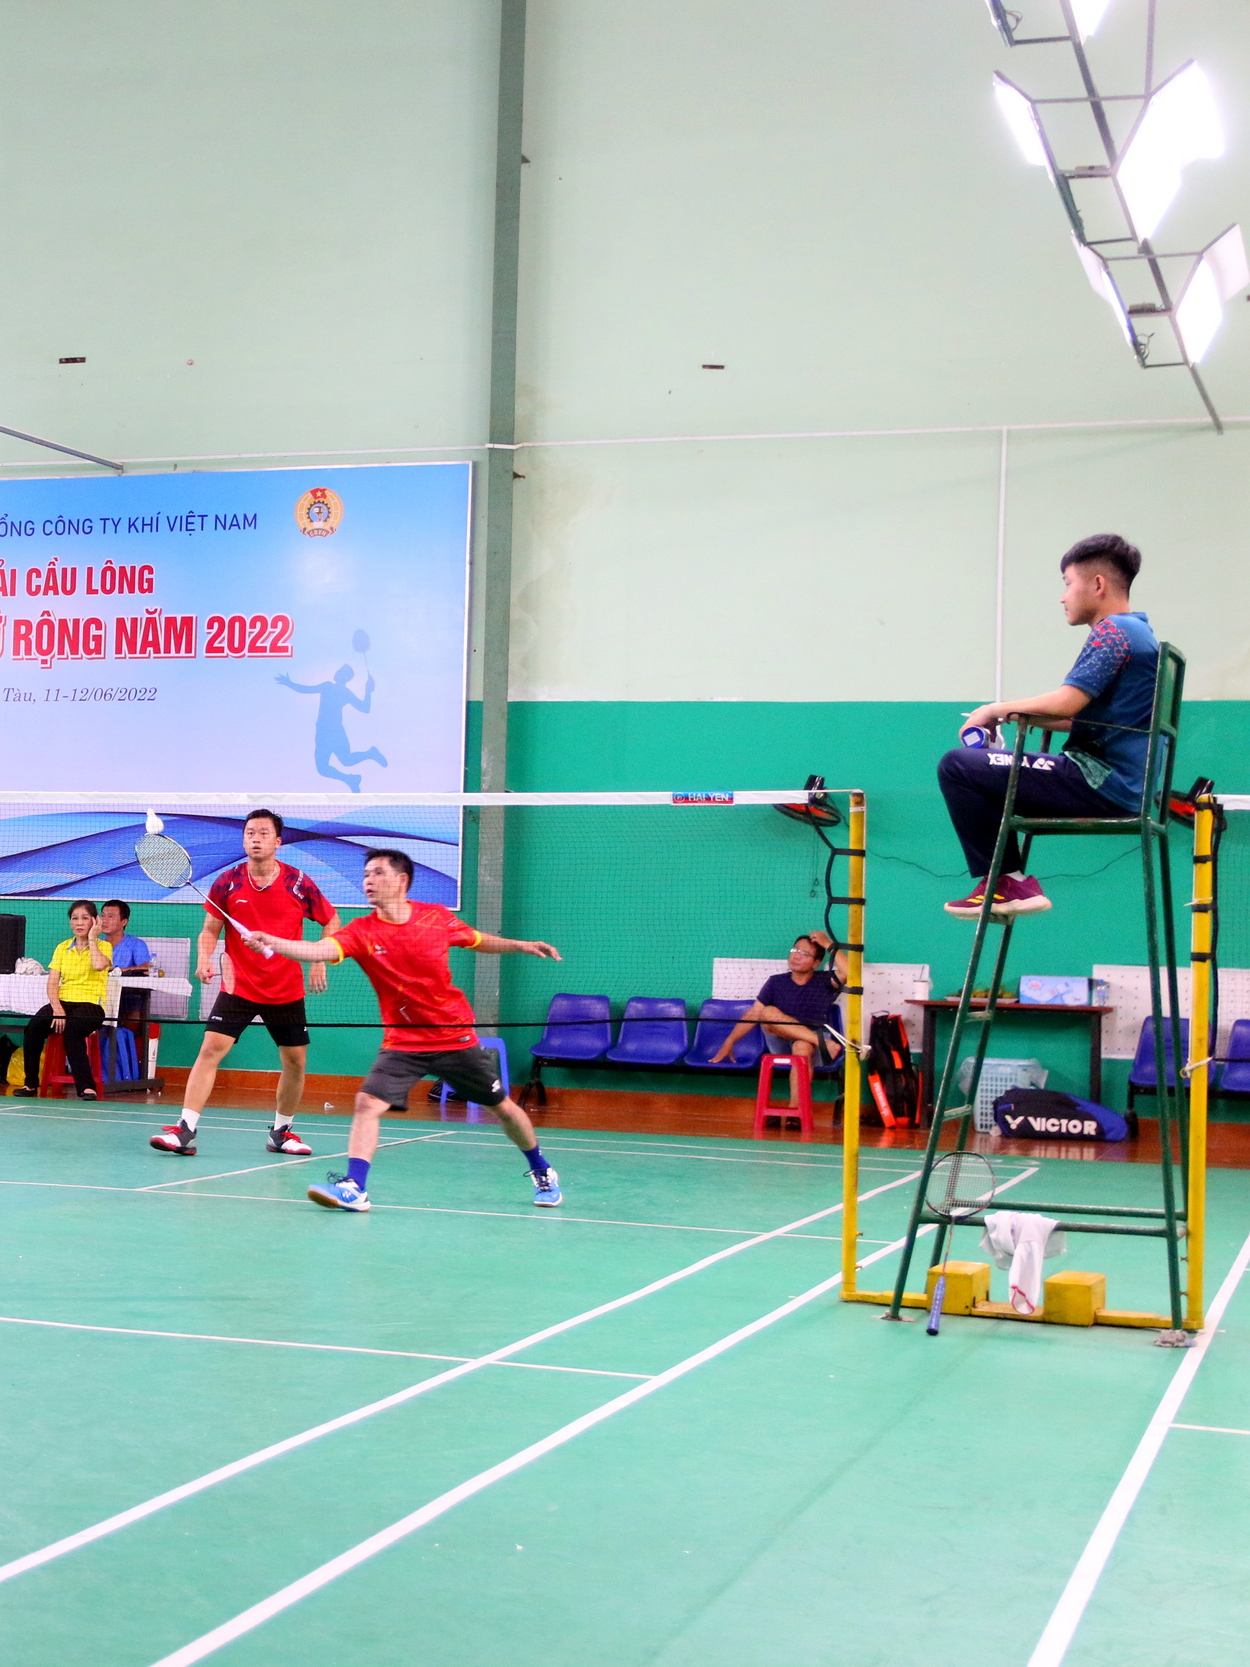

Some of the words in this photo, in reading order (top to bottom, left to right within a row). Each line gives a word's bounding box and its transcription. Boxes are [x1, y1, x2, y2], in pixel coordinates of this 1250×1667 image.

[42, 514, 94, 537] CÔNG
[99, 517, 122, 535] TY
[127, 511, 162, 534] KHÍ
[166, 510, 209, 537] VIỆT
[213, 512, 258, 532] NAM
[25, 556, 78, 597] CẦU
[85, 559, 155, 596] LÔNG
[11, 609, 107, 669] RỘNG
[113, 607, 198, 660] NĂM
[204, 612, 295, 659] 2022
[2, 686, 37, 705] Tàu,
[42, 686, 158, 703] 11-12/06/2022
[987, 752, 1030, 769] YNEX
[1027, 1116, 1098, 1136] VICTOR
